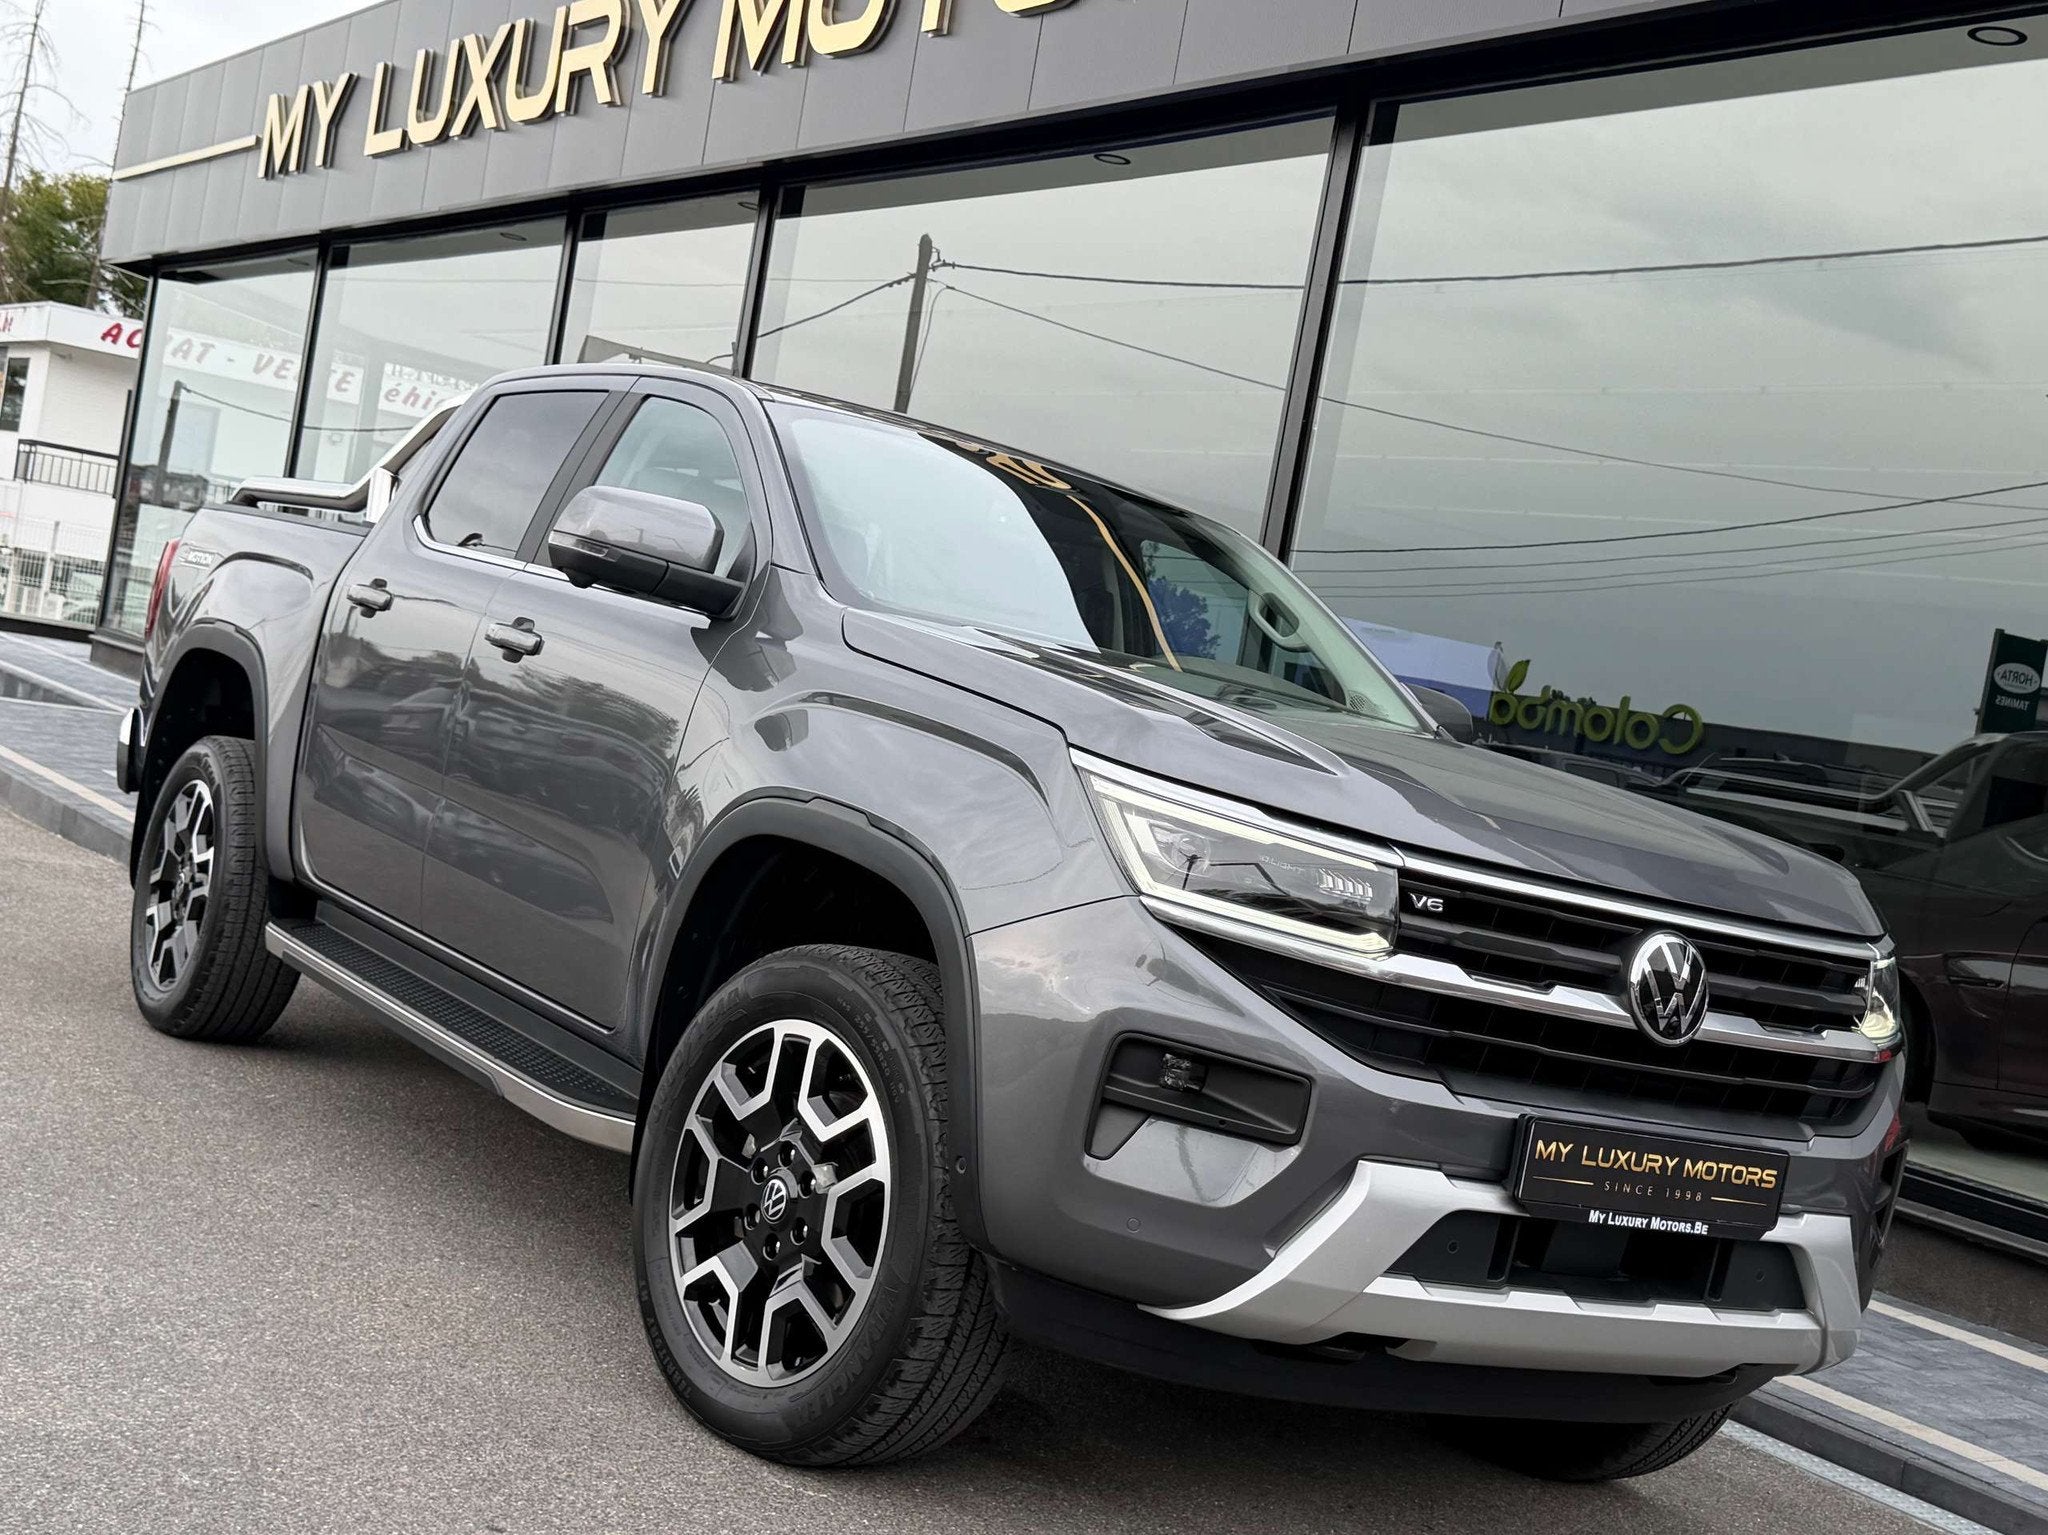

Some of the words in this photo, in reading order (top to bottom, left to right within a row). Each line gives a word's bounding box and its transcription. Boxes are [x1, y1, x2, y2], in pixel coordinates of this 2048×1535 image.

[258, 72, 358, 180] MY
[364, 0, 688, 157] LUXURY
[1409, 892, 1444, 913] V6
[1534, 1140, 1575, 1164] MY
[1580, 1144, 1680, 1176] LUXURY
[1682, 1157, 1778, 1189] MOTORS
[1604, 1180, 1654, 1197] SINCE
[1665, 1187, 1703, 1202] 1998
